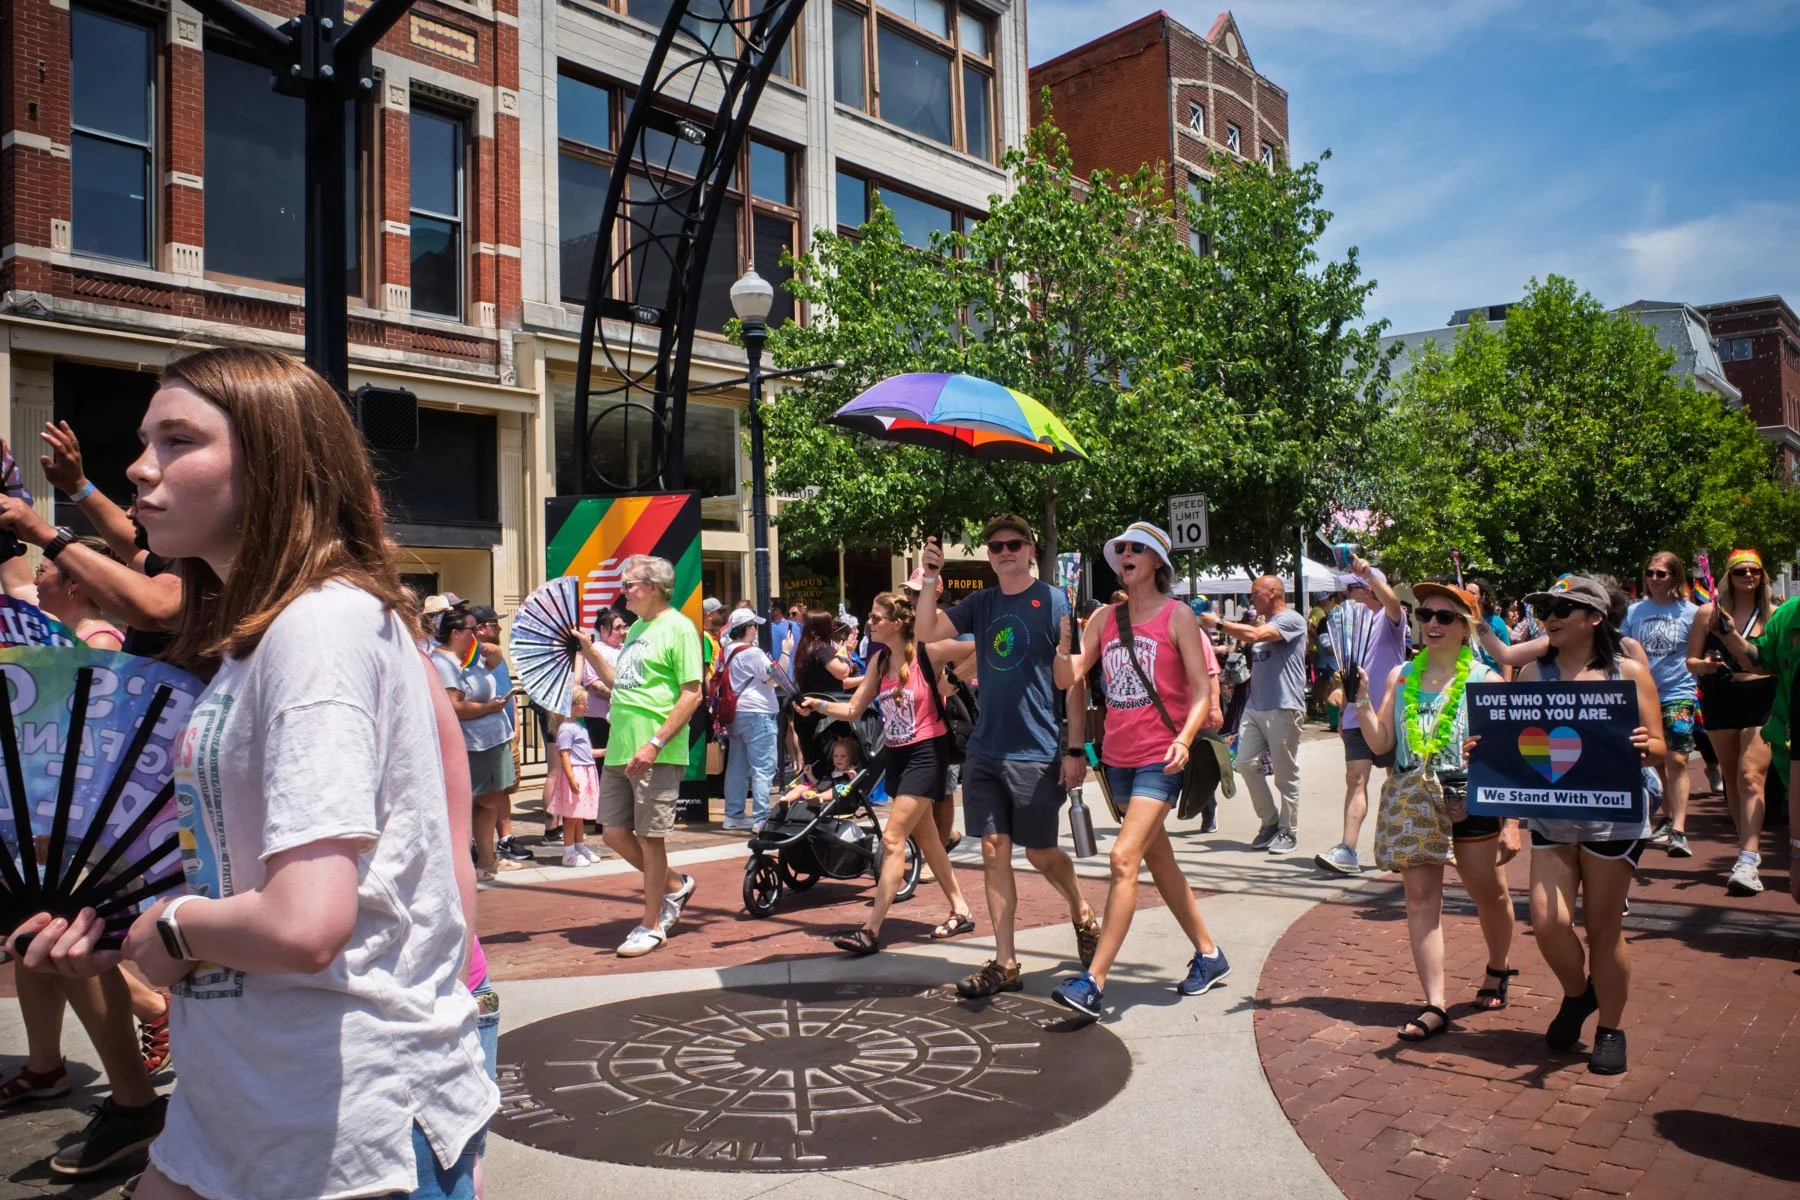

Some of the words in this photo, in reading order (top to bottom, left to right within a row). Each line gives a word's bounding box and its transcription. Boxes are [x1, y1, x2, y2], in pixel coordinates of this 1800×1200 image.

[1172, 500, 1203, 509] SPEED
[1176, 511, 1200, 521] LIMIT
[1177, 523, 1201, 543] 10
[948, 579, 984, 589] PROPER
[1475, 694, 1507, 706] LOVE
[1510, 694, 1543, 706] WHO
[1546, 693, 1576, 706] YOU
[1580, 692, 1627, 705] WANT.
[1489, 709, 1506, 720] BE
[1509, 709, 1541, 720] WHO
[1545, 708, 1575, 720] YOU
[1578, 708, 1612, 720] ARE.
[1483, 789, 1505, 801] We
[1509, 790, 1549, 803] Stand
[1554, 791, 1588, 805] With
[1592, 793, 1625, 806] You!
[654, 1138, 828, 1161] MALL
